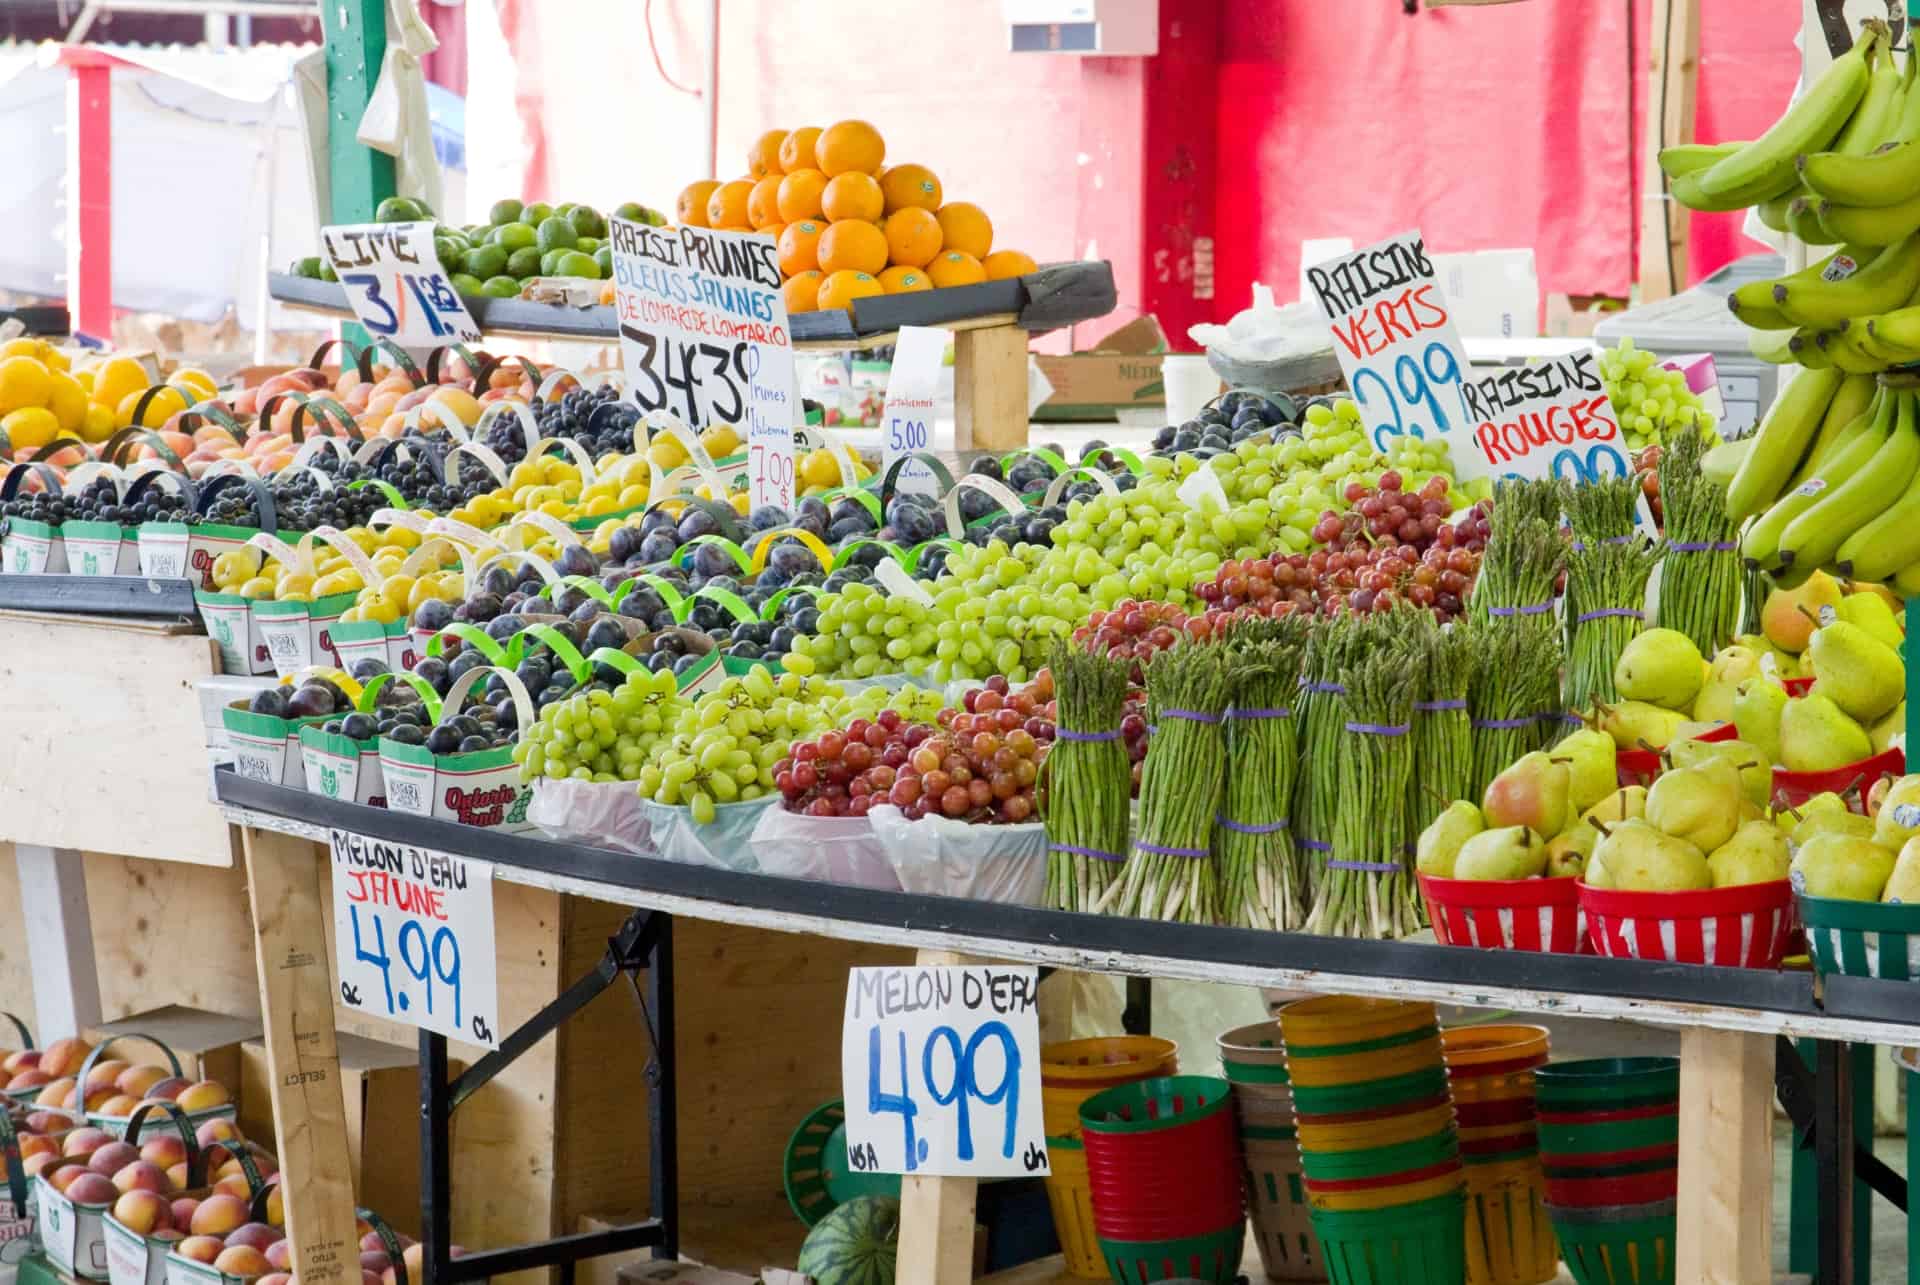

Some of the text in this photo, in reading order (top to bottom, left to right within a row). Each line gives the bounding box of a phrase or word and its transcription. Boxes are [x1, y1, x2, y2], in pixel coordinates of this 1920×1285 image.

[324, 223, 420, 268] LIME
[611, 219, 682, 268] RAISI
[679, 226, 782, 290] PRUNES
[613, 255, 688, 305] BLEUS
[687, 271, 777, 323] JAUNES
[1306, 239, 1435, 319] RAISINS
[617, 290, 640, 321] DE
[711, 313, 788, 346] L'ONTARIO
[1330, 283, 1448, 360] VERTS
[749, 344, 787, 404] Prunes
[1352, 341, 1472, 454] 2.99
[1462, 353, 1603, 423] RAISINS
[889, 418, 927, 451] 5.00
[1475, 395, 1617, 465] ROUGES
[332, 830, 468, 891] MELON D'EAU
[346, 871, 449, 921] JAUNE
[350, 904, 461, 1028] 4.99
[853, 968, 1039, 1019] MELON D'EAU
[285, 1069, 326, 1087] SELECT
[868, 1020, 1022, 1172] 4.99
[849, 1142, 880, 1171] USA
